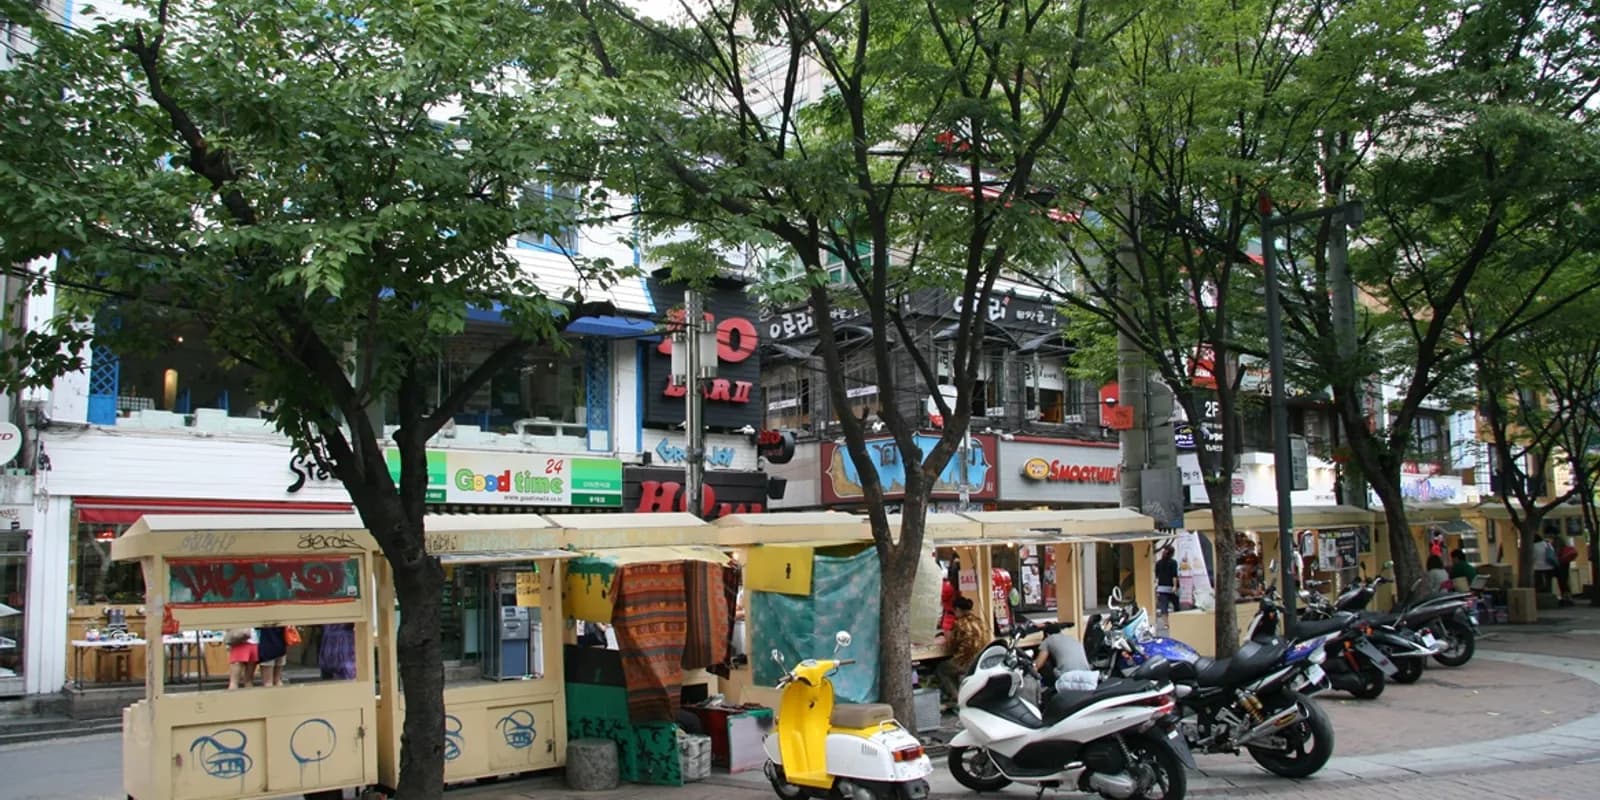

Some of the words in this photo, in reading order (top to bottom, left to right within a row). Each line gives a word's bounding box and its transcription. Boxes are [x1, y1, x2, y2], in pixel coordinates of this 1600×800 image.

[1205, 401, 1219, 418] 2F
[545, 459, 564, 474] 24
[455, 468, 511, 492] Good
[514, 471, 563, 494] time
